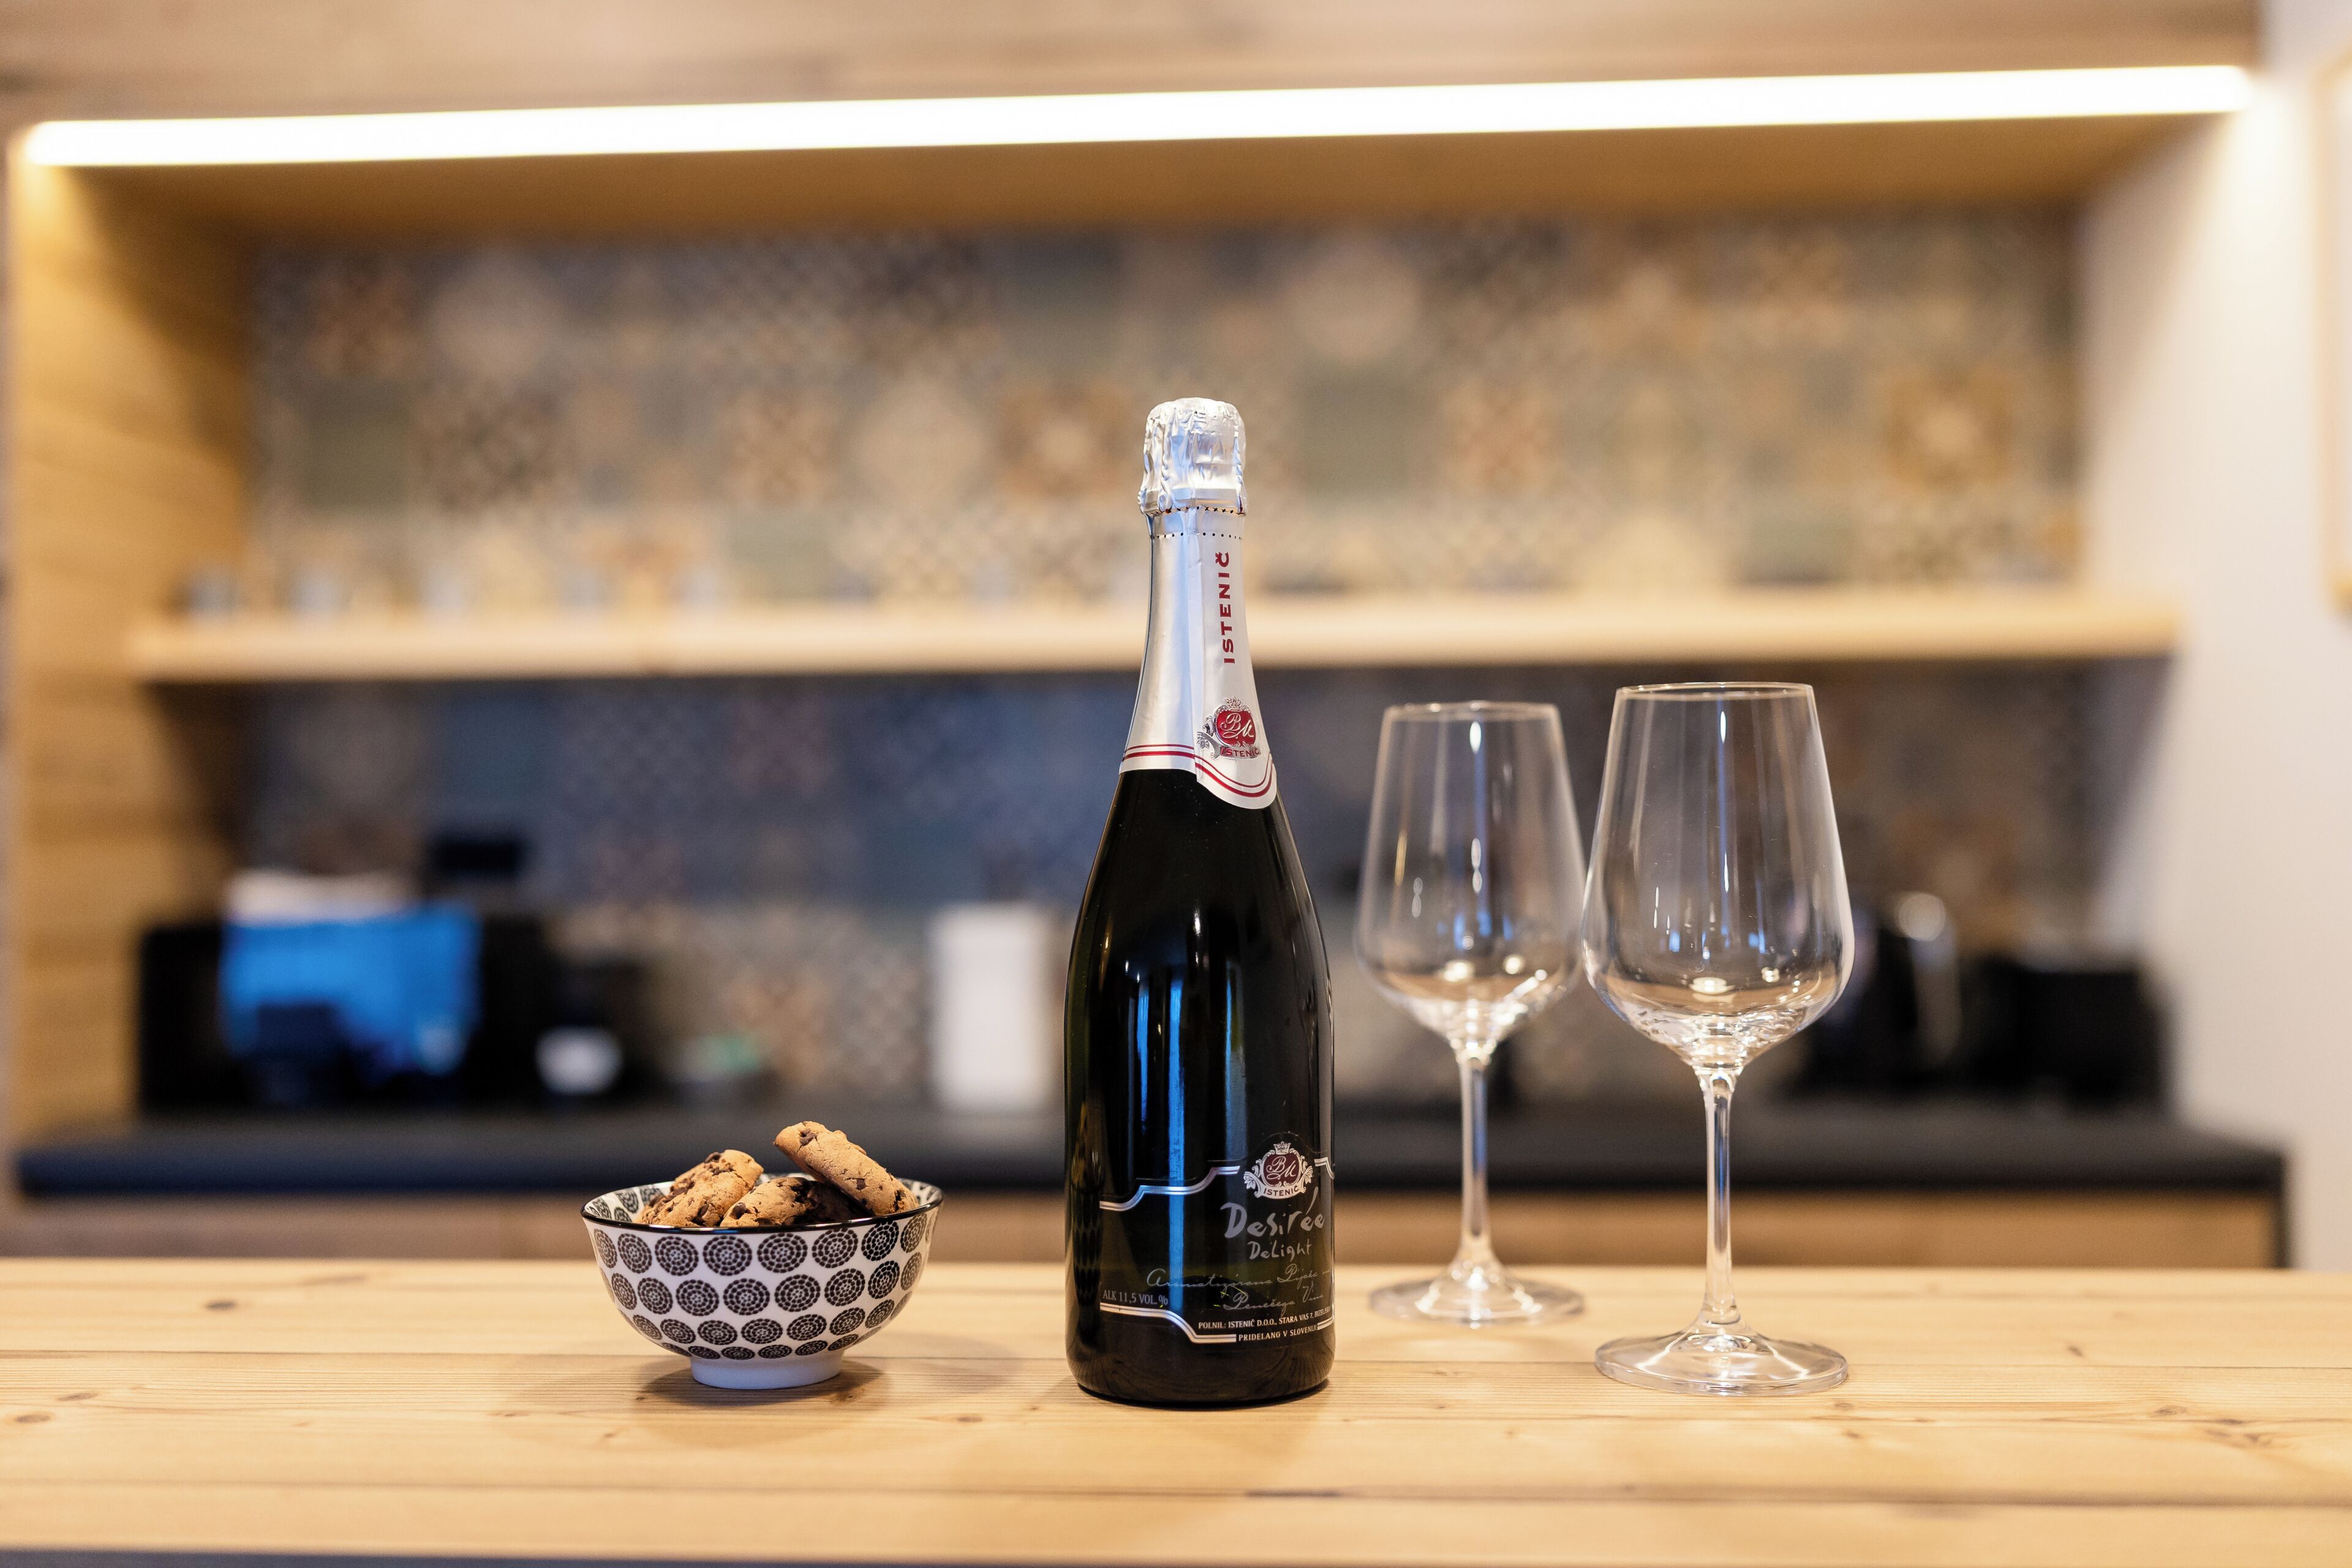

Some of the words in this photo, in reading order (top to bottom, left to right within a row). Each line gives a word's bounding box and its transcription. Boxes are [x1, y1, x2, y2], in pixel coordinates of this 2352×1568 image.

[1215, 552, 1235, 664] ISTENIČ
[1220, 747, 1260, 757] ISTENIČ
[1264, 1185, 1300, 1196] ISTENIČ
[1220, 1186, 1325, 1238] Desirée
[1102, 1289, 1117, 1301] ALK
[1119, 1291, 1136, 1304] 11,5
[1139, 1293, 1158, 1305] VOL.
[1158, 1294, 1168, 1305] %
[1228, 1319, 1255, 1328] ISTENIČ
[1279, 1315, 1297, 1324] STARA
[1290, 1324, 1316, 1336] SLOVENIJI
